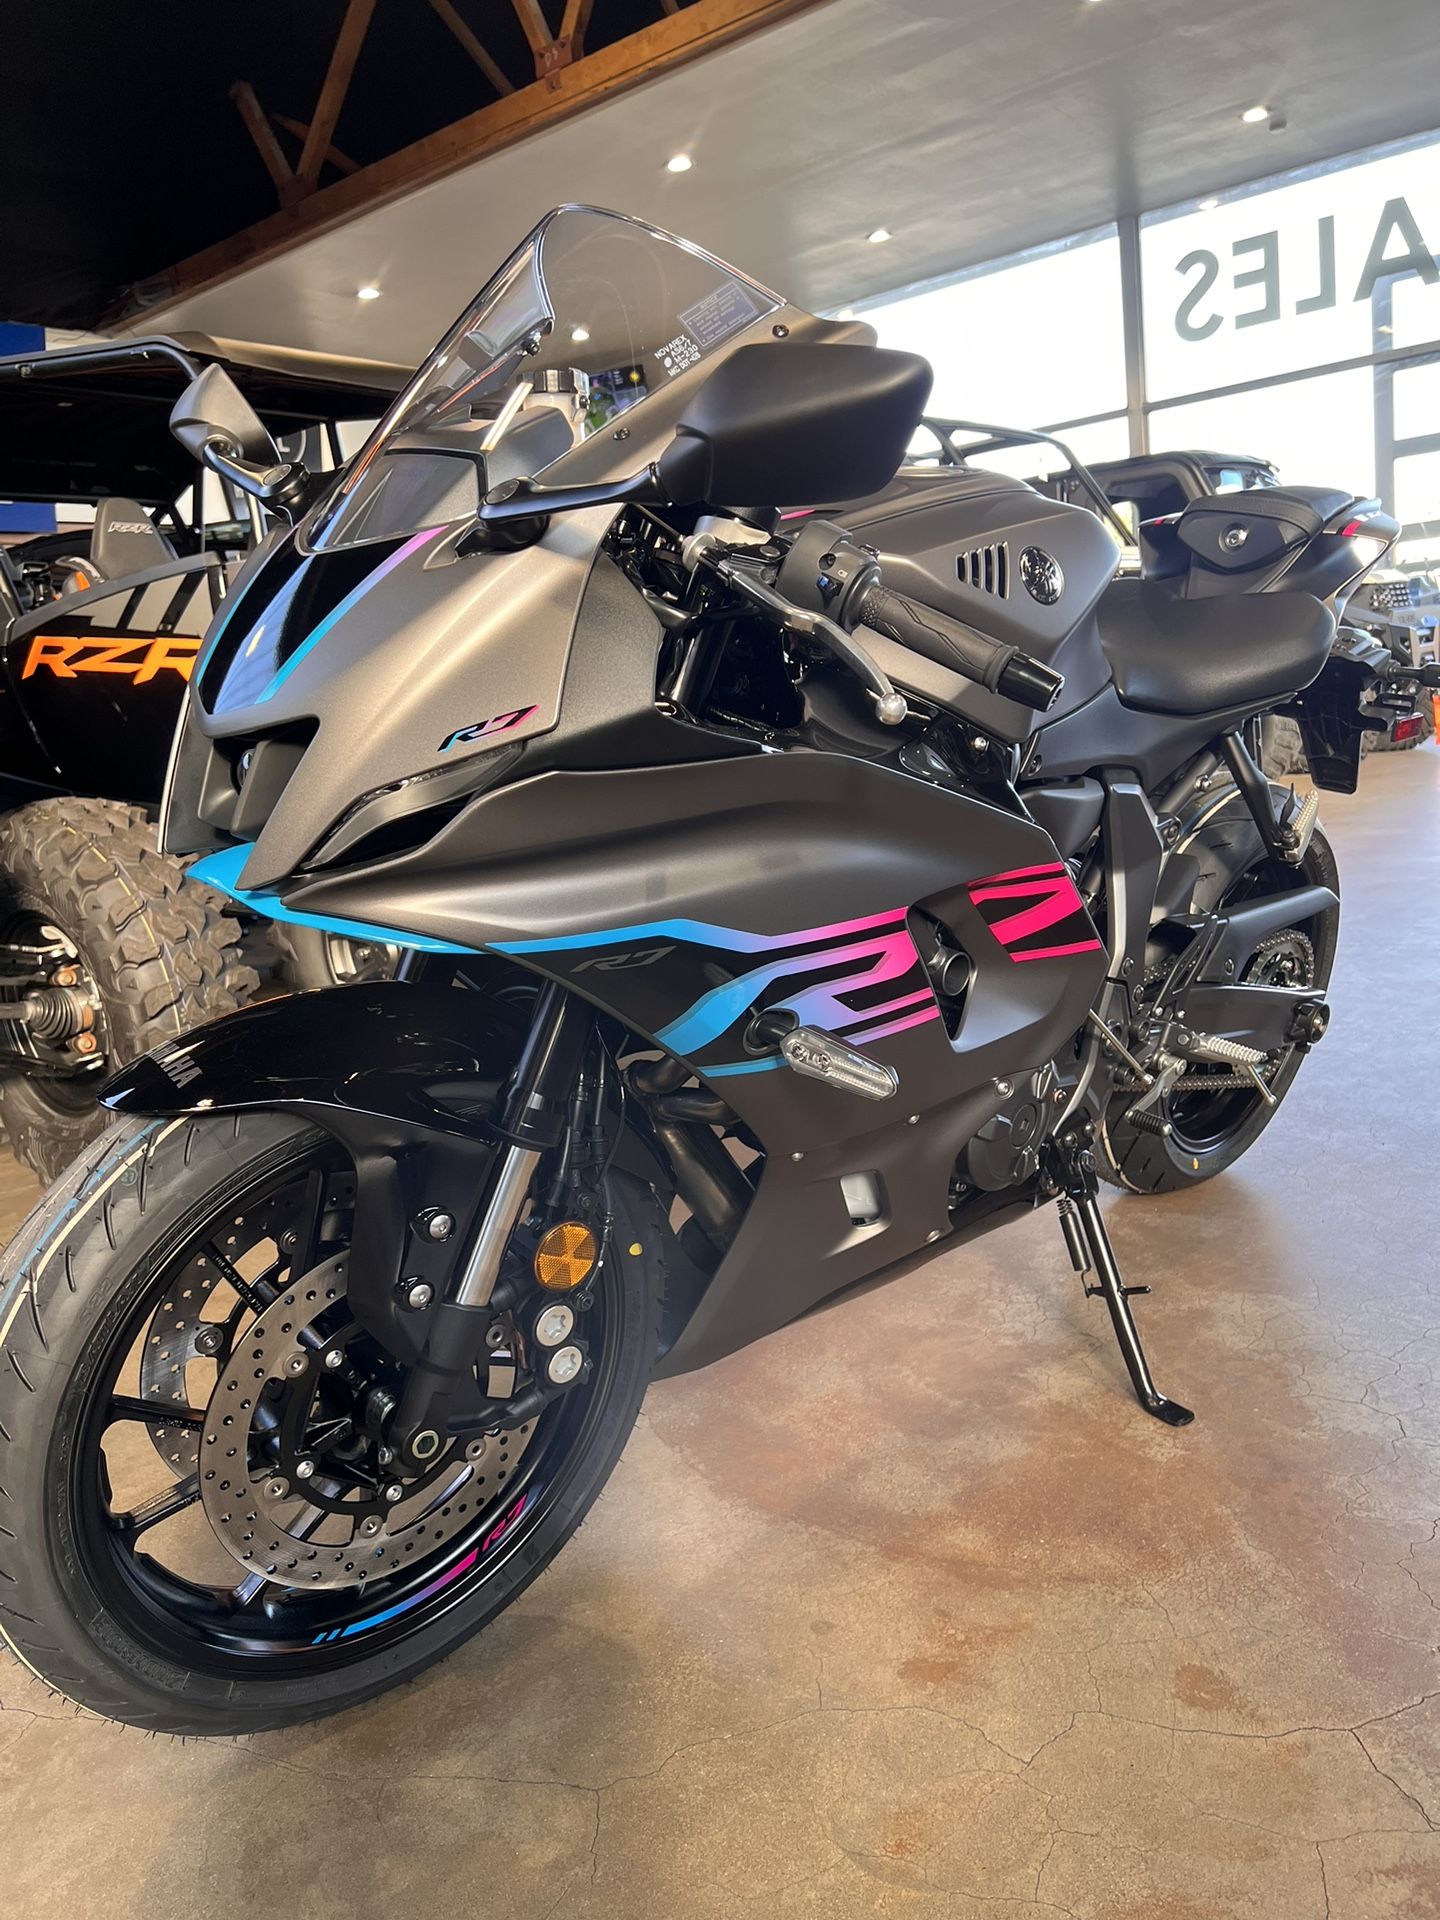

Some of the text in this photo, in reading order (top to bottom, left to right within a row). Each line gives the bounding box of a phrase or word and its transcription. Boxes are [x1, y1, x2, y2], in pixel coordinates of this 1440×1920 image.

[654, 334, 688, 360] NOVAREX
[673, 344, 699, 365] M-230
[437, 704, 540, 753] R7
[569, 945, 677, 973] R7
[482, 1493, 528, 1552] R7
